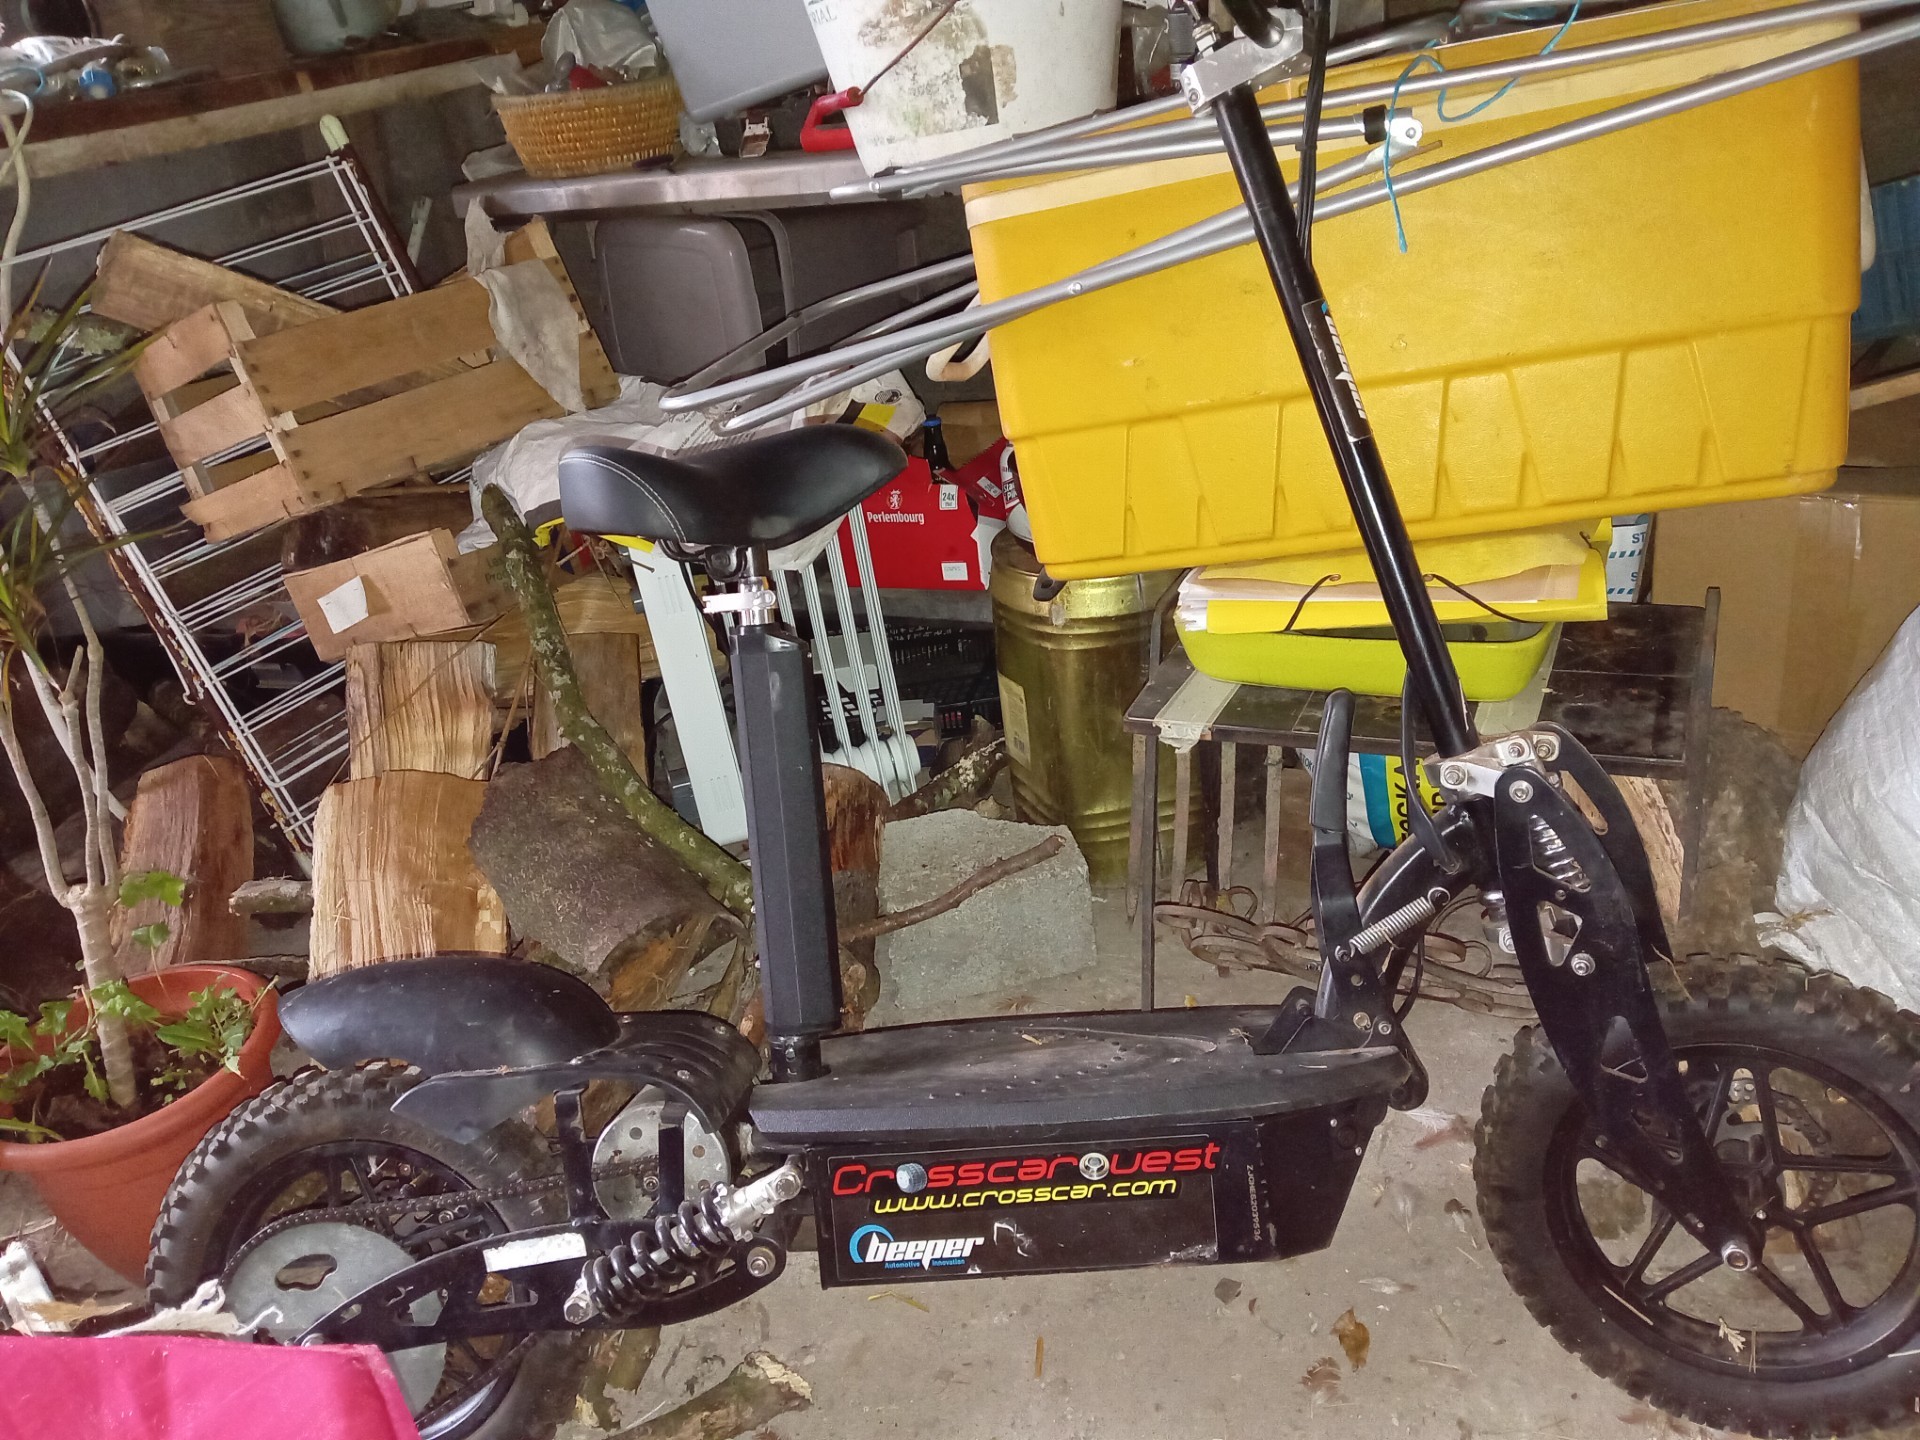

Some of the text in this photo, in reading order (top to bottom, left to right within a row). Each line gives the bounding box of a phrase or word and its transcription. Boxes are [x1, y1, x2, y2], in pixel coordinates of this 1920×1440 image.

[866, 511, 925, 526] Perlembourg
[874, 1179, 1177, 1214] www.crosscar.com
[865, 1231, 985, 1271] beeper
[884, 1259, 965, 1269] Automotive Innovation
